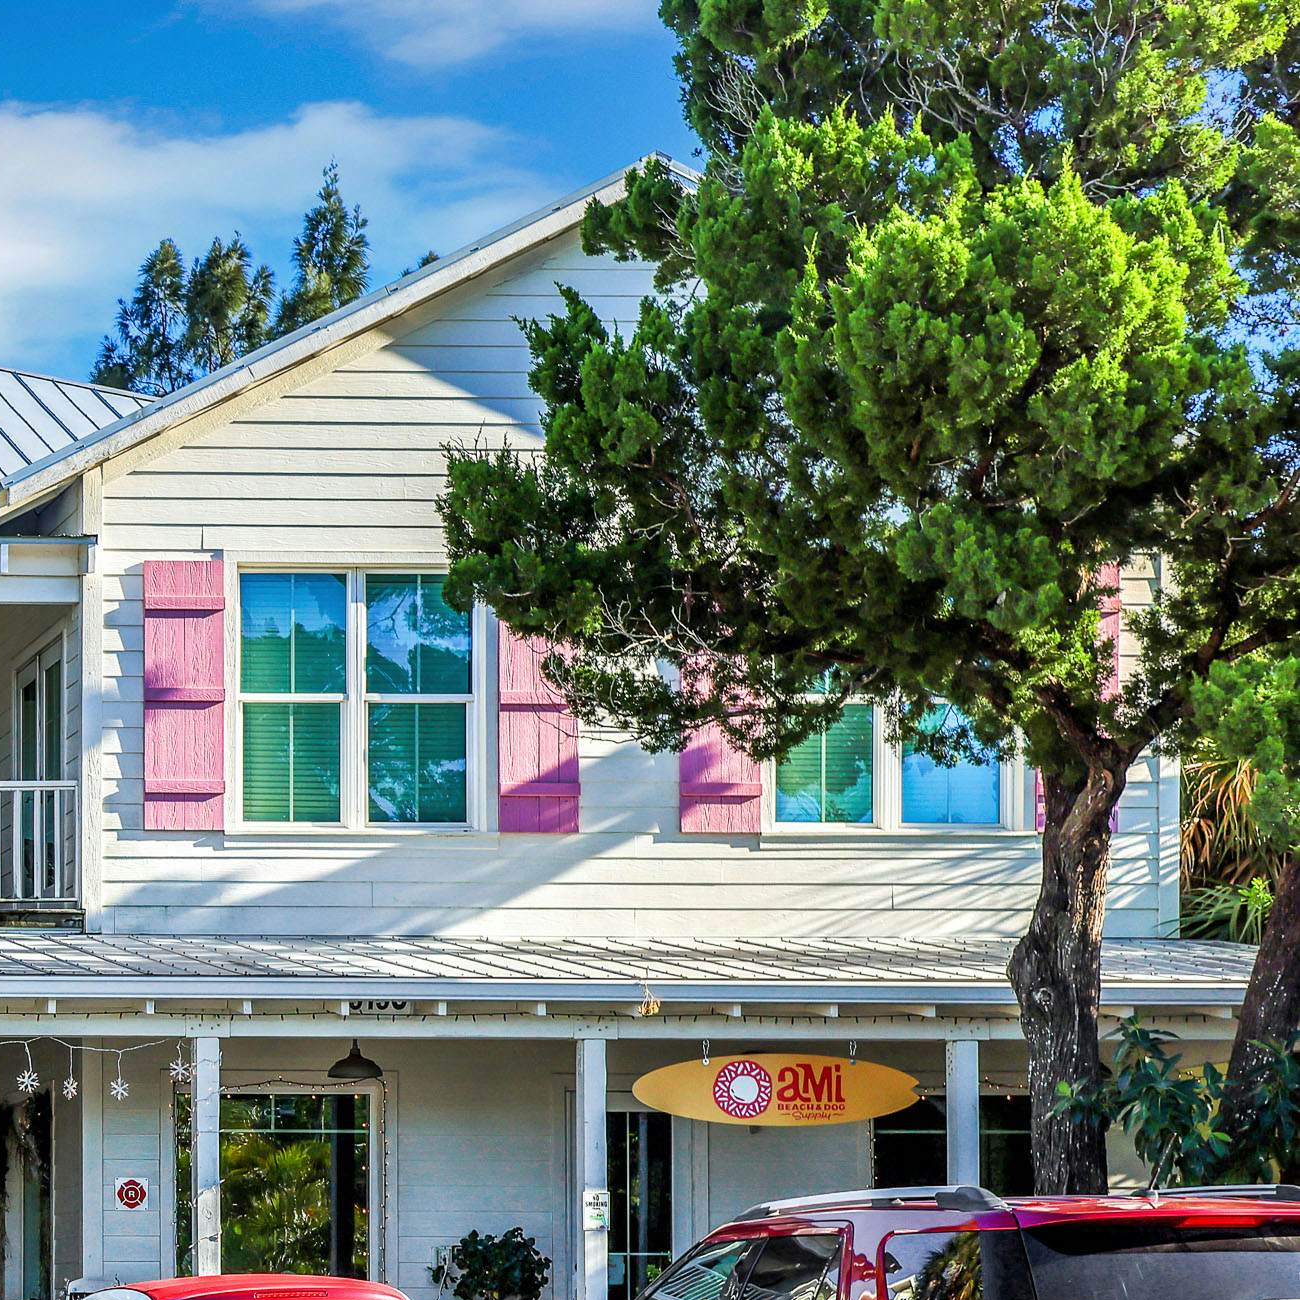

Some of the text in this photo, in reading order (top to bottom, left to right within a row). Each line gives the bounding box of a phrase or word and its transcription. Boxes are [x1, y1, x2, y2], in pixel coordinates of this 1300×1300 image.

[823, 1103, 846, 1111] DOG
[791, 1111, 832, 1121] Supply
[128, 1190, 136, 1198] R
